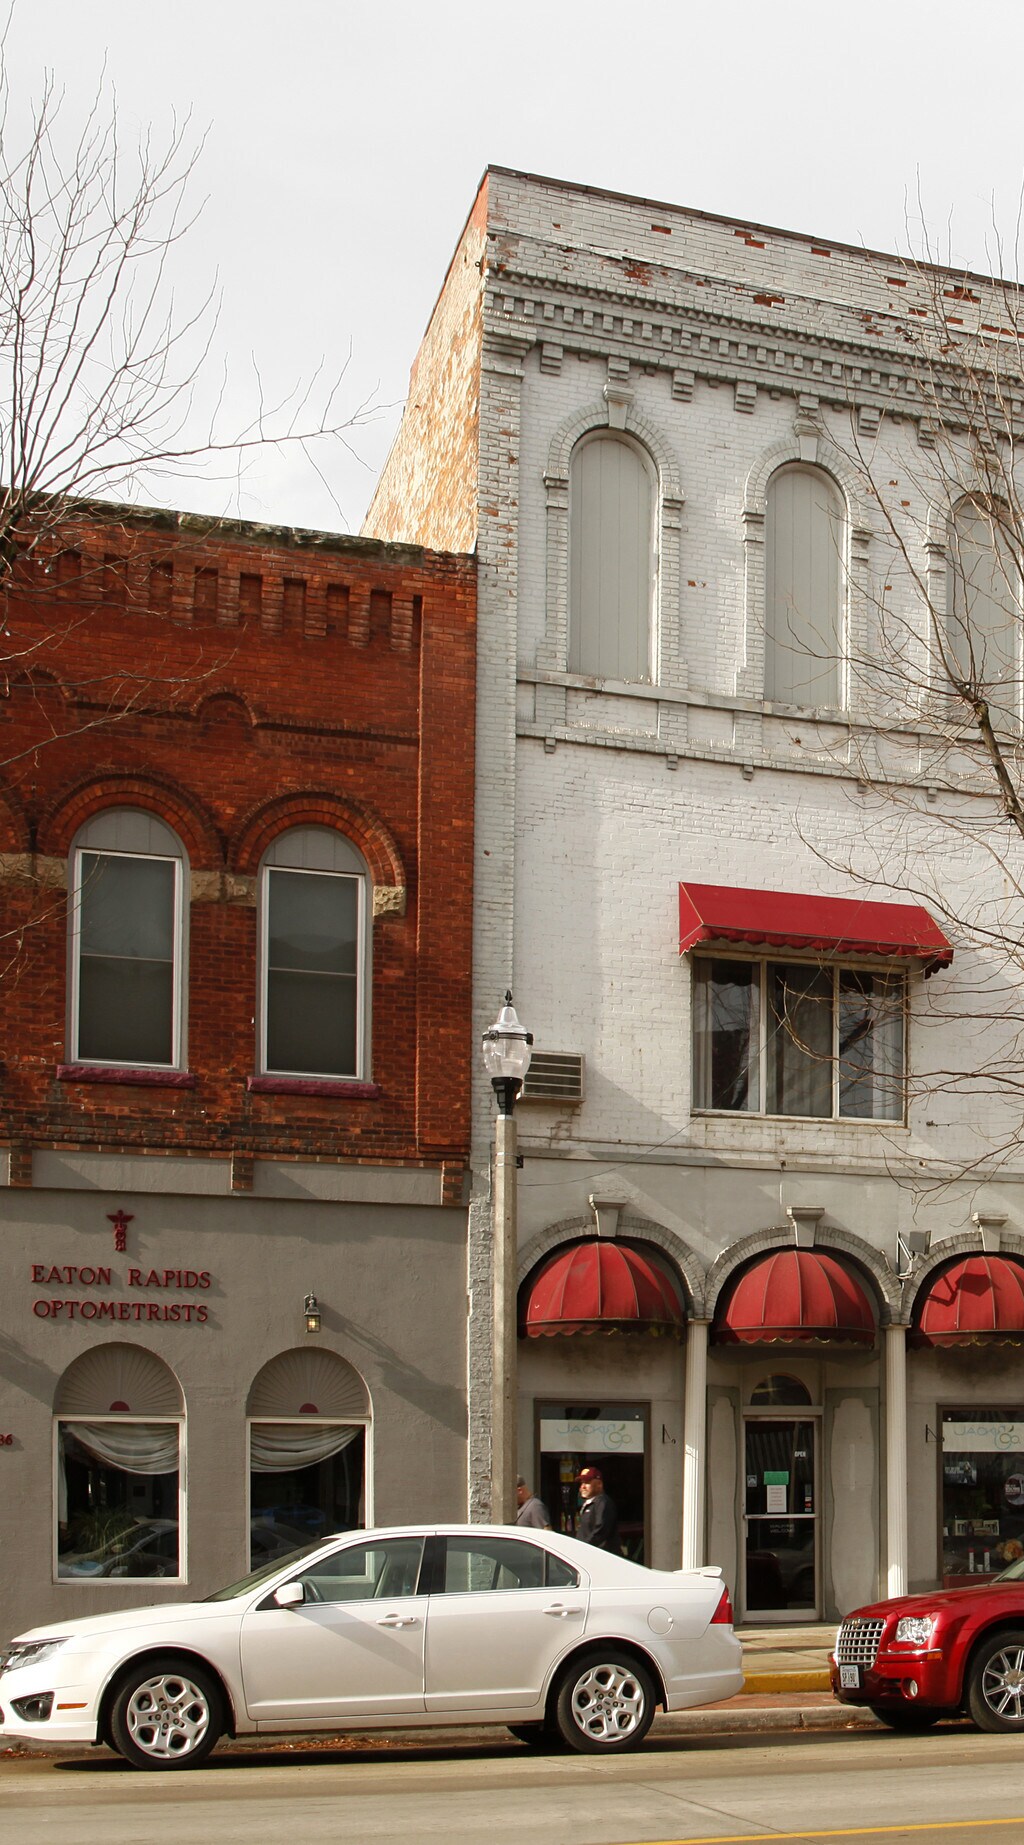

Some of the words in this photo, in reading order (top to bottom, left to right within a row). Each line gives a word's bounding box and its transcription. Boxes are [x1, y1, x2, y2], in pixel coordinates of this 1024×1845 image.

[31, 1264, 112, 1286] EATON
[128, 1268, 211, 1289] RAPIDS
[33, 1300, 209, 1323] OPTOMETRISTS
